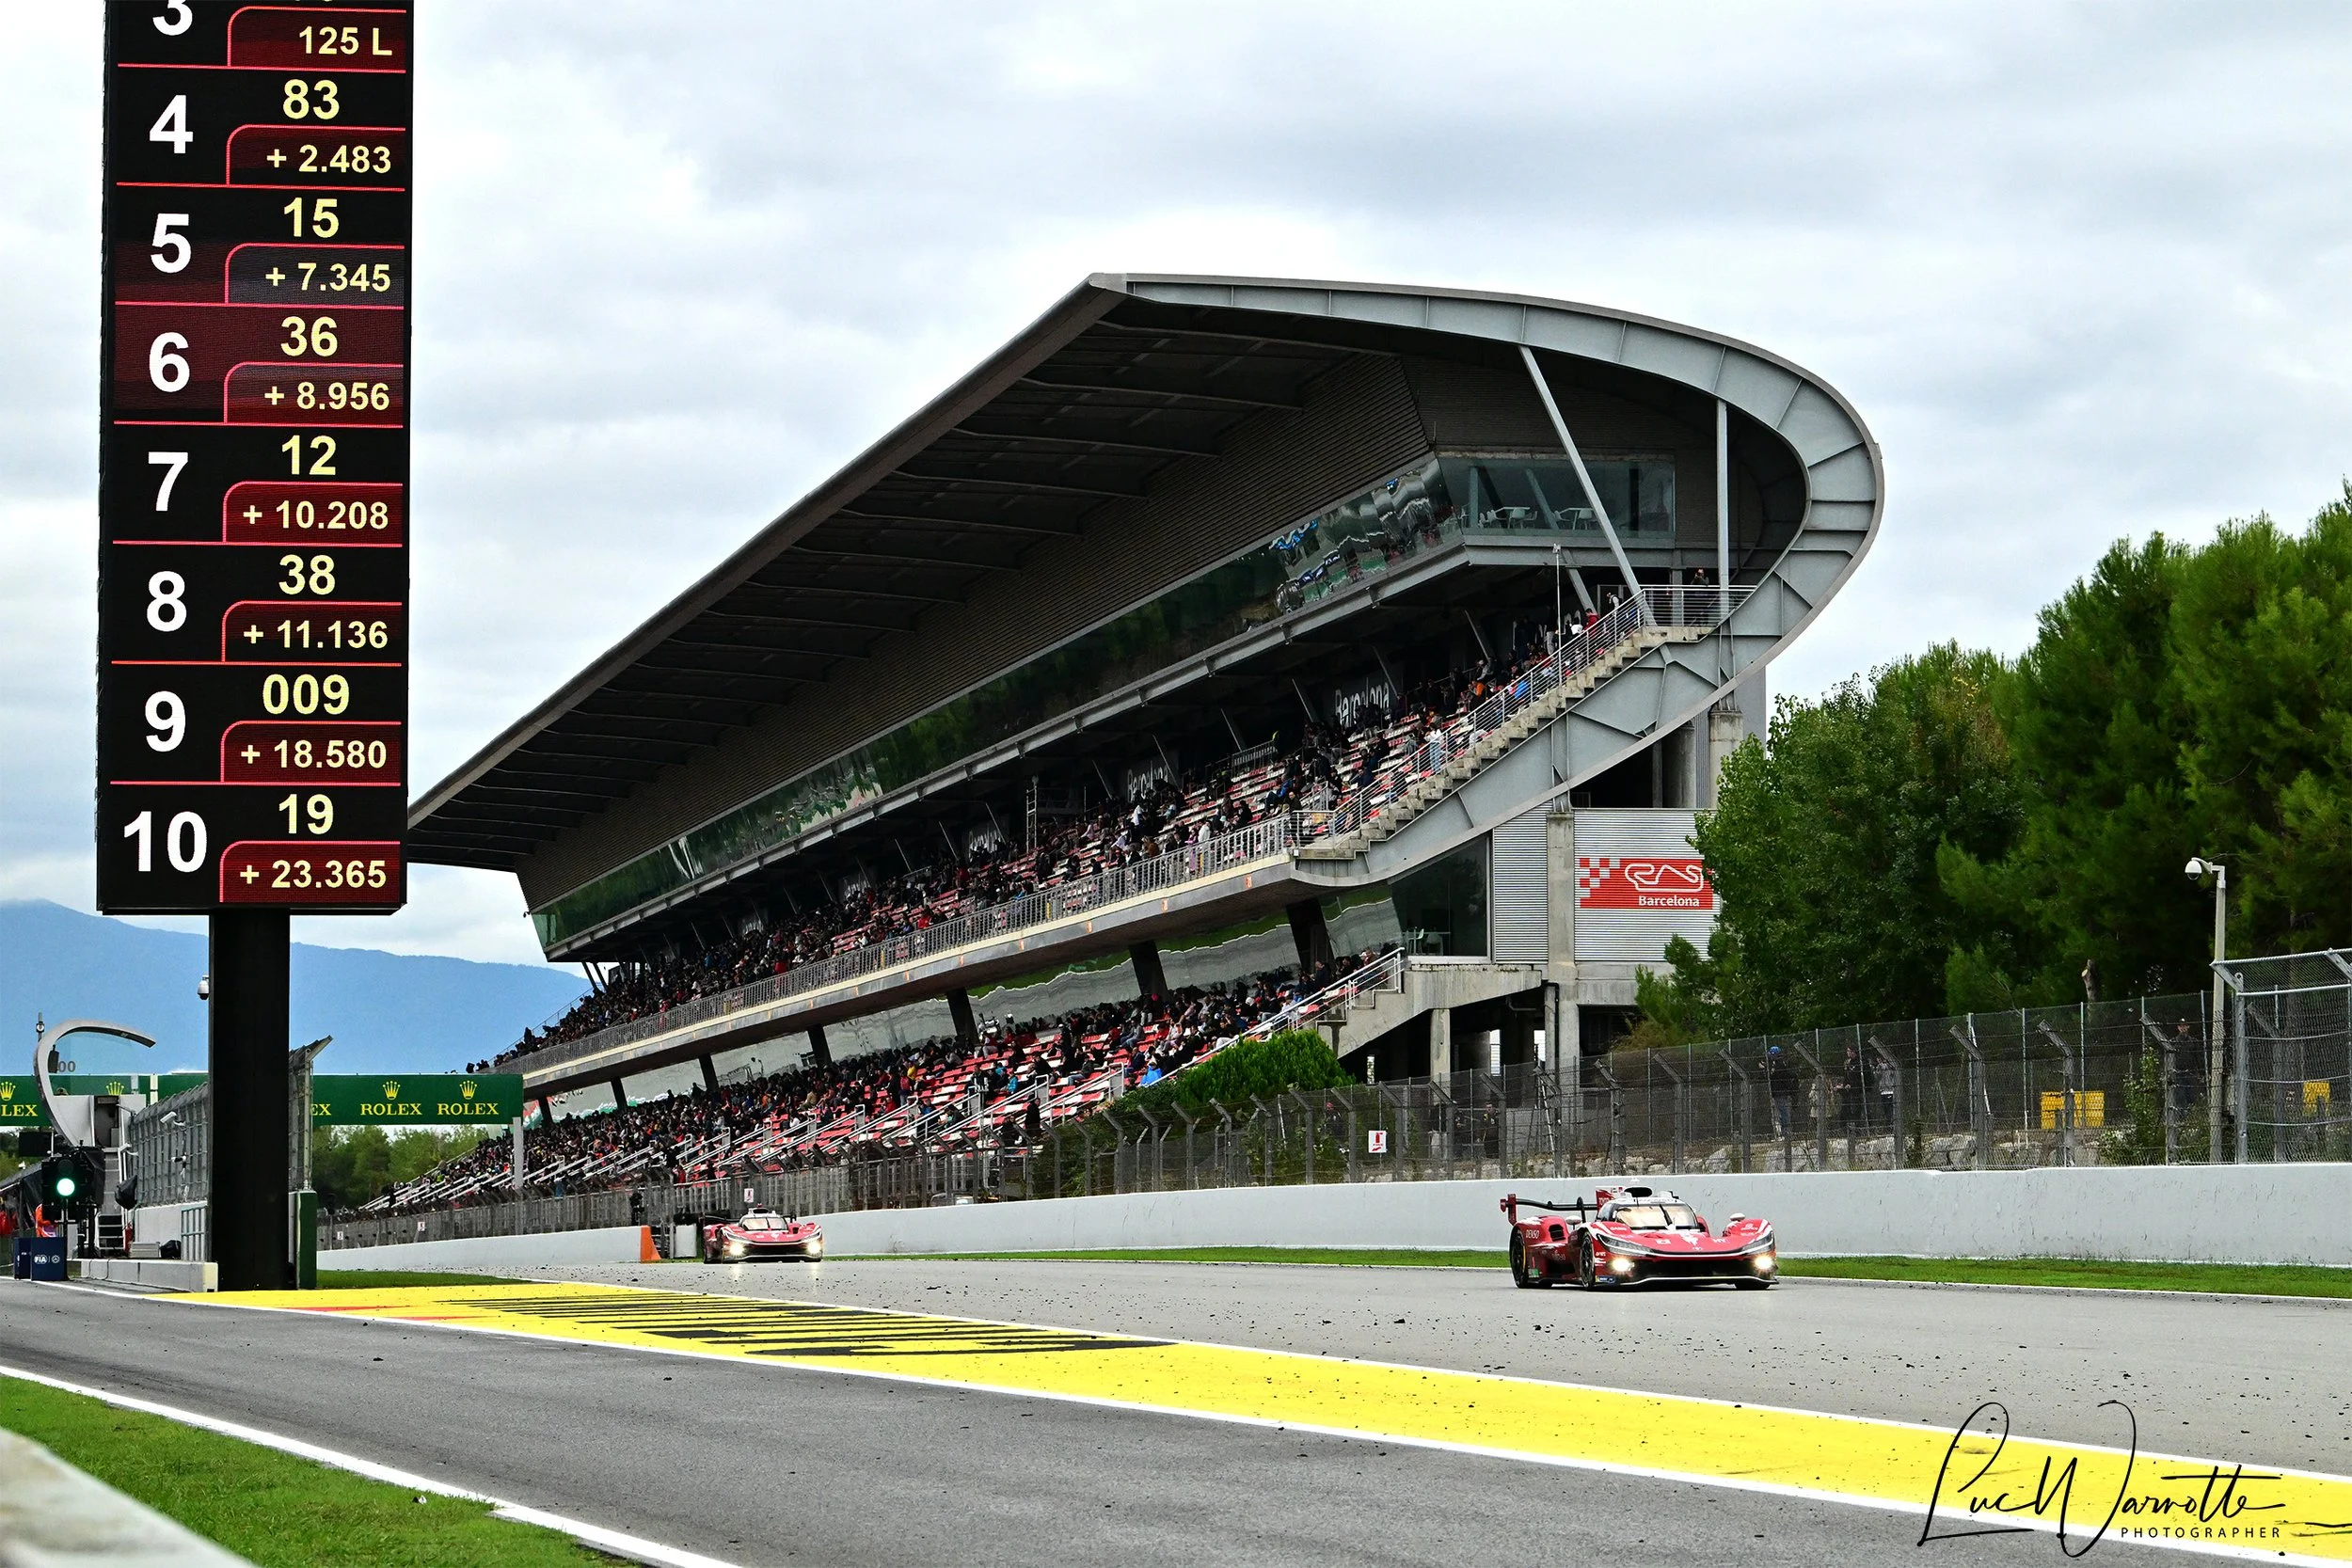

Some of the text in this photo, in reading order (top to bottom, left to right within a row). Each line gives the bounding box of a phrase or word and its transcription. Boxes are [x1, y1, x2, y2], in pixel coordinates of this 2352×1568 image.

[152, 0, 194, 36] 3
[299, 26, 393, 56] 125 L
[282, 79, 340, 120] 83
[149, 94, 194, 154] 4
[266, 144, 392, 173] + 2.483
[283, 197, 340, 238] 15
[150, 213, 192, 274] 5
[265, 262, 391, 293] + 7.345
[280, 316, 338, 357] 36
[149, 331, 190, 393] 6
[263, 381, 390, 411] + 8.956
[281, 435, 337, 476] 12
[148, 451, 189, 512] 7
[243, 499, 389, 530] + 10.208
[278, 554, 336, 595] 38
[146, 570, 187, 632] 8
[243, 619, 389, 649] + 11.136
[262, 673, 350, 715] 009
[145, 690, 186, 752] 9
[241, 739, 387, 769] + 18.580
[278, 794, 334, 835] 19
[123, 811, 208, 873] 10
[239, 860, 387, 889] + 23.365
[1638, 895, 1700, 908] Barcelona
[58, 1060, 76, 1072] 00
[1, 1104, 39, 1117] LEX
[360, 1103, 422, 1116] ROLEX
[437, 1102, 499, 1116] ROLEX
